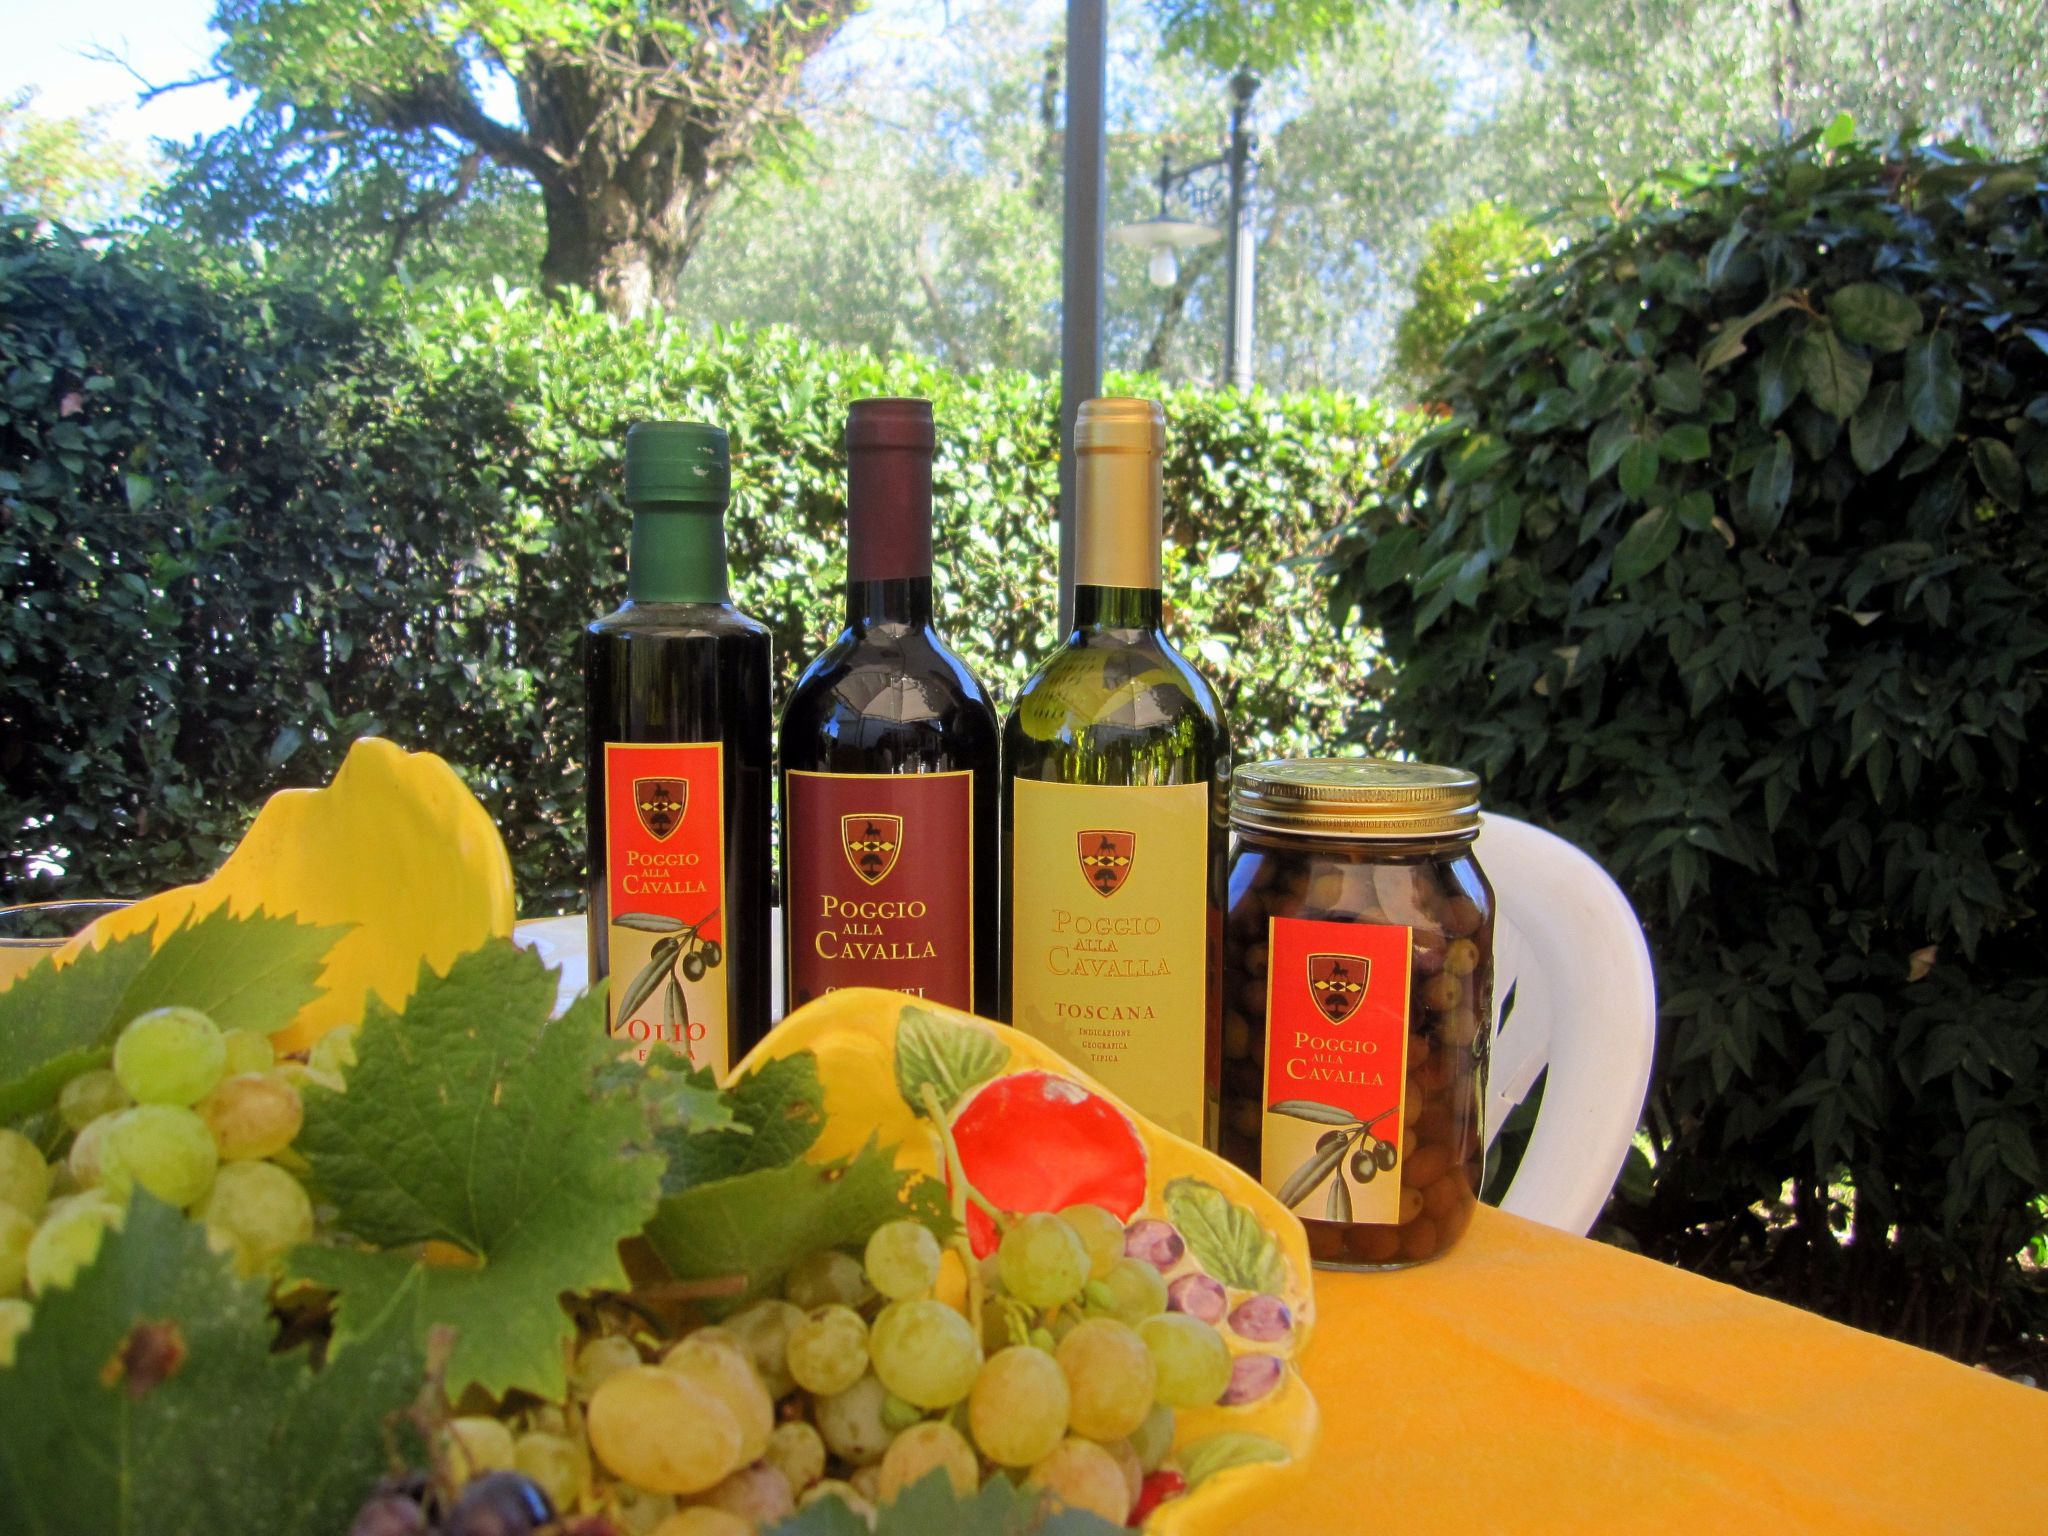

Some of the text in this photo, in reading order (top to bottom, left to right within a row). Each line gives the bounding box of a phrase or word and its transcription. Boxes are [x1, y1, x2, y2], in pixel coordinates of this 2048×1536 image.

[1343, 819, 1382, 829] BORMIOLI
[1384, 819, 1407, 829] ROCCO
[626, 850, 700, 866] POGGIO
[641, 868, 670, 877] ALLA
[622, 874, 708, 895] CAVALLA
[820, 894, 927, 919] POGGIO
[842, 923, 883, 935] ALLA
[1051, 909, 1161, 936] POGGIO
[815, 930, 938, 960] CAVALLA
[1074, 938, 1119, 952] ALLA
[1046, 945, 1171, 978] CAVALLA
[1055, 1002, 1155, 1021] TOSCANA
[628, 1019, 707, 1042] OLIO
[1079, 1027, 1132, 1037] INDICAZIONE
[1082, 1040, 1128, 1050] GEOGRAFICA
[1294, 1031, 1378, 1055] POGGIO
[1091, 1053, 1119, 1062] TIPICA
[1312, 1053, 1343, 1065] ALLA
[1286, 1058, 1384, 1086] CAVALLA
